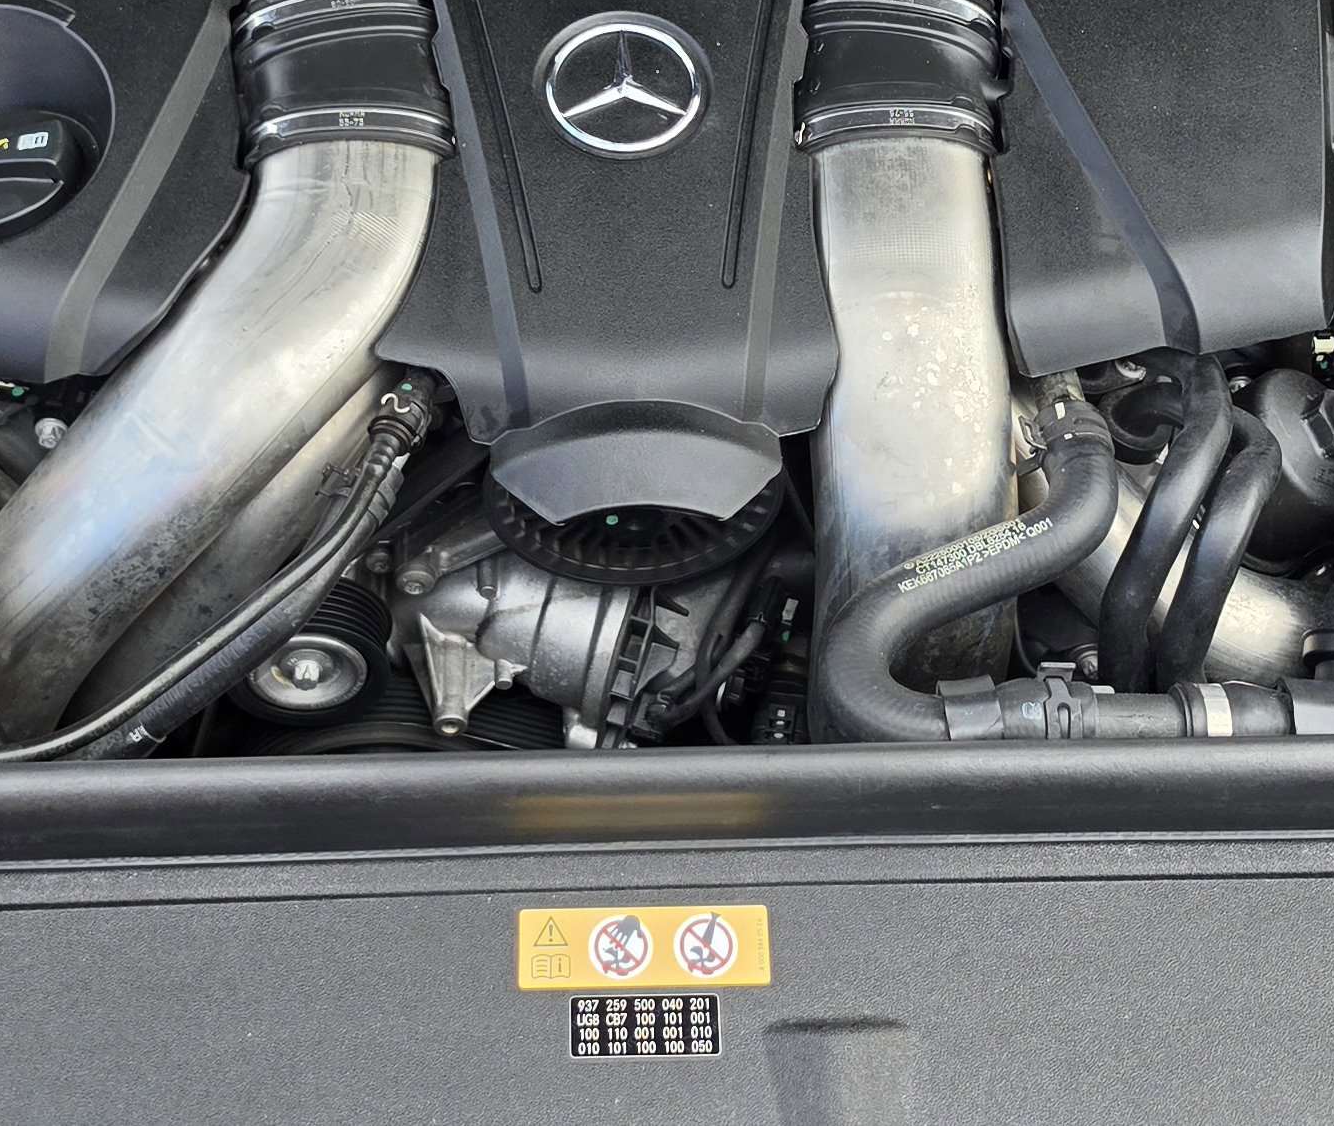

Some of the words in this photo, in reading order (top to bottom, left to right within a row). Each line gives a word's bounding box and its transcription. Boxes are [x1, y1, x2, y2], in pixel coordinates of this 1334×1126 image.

[1026, 517, 1053, 538] Q001
[578, 999, 599, 1013] 937
[606, 999, 627, 1012] 259
[634, 998, 655, 1011] 500
[662, 998, 683, 1011] 040
[690, 997, 710, 1010] 201
[635, 1012, 656, 1025] 100
[664, 1011, 683, 1025] 101
[690, 1011, 710, 1025] 001
[579, 1027, 600, 1041] 100
[608, 1027, 628, 1041] 110
[634, 1026, 655, 1040] 001
[663, 1026, 683, 1039] 001
[690, 1025, 712, 1039] 010
[578, 1041, 600, 1055] 010
[608, 1041, 627, 1055] 101
[636, 1040, 657, 1054] 100
[665, 1040, 685, 1054] 100
[691, 1039, 713, 1053] 050
